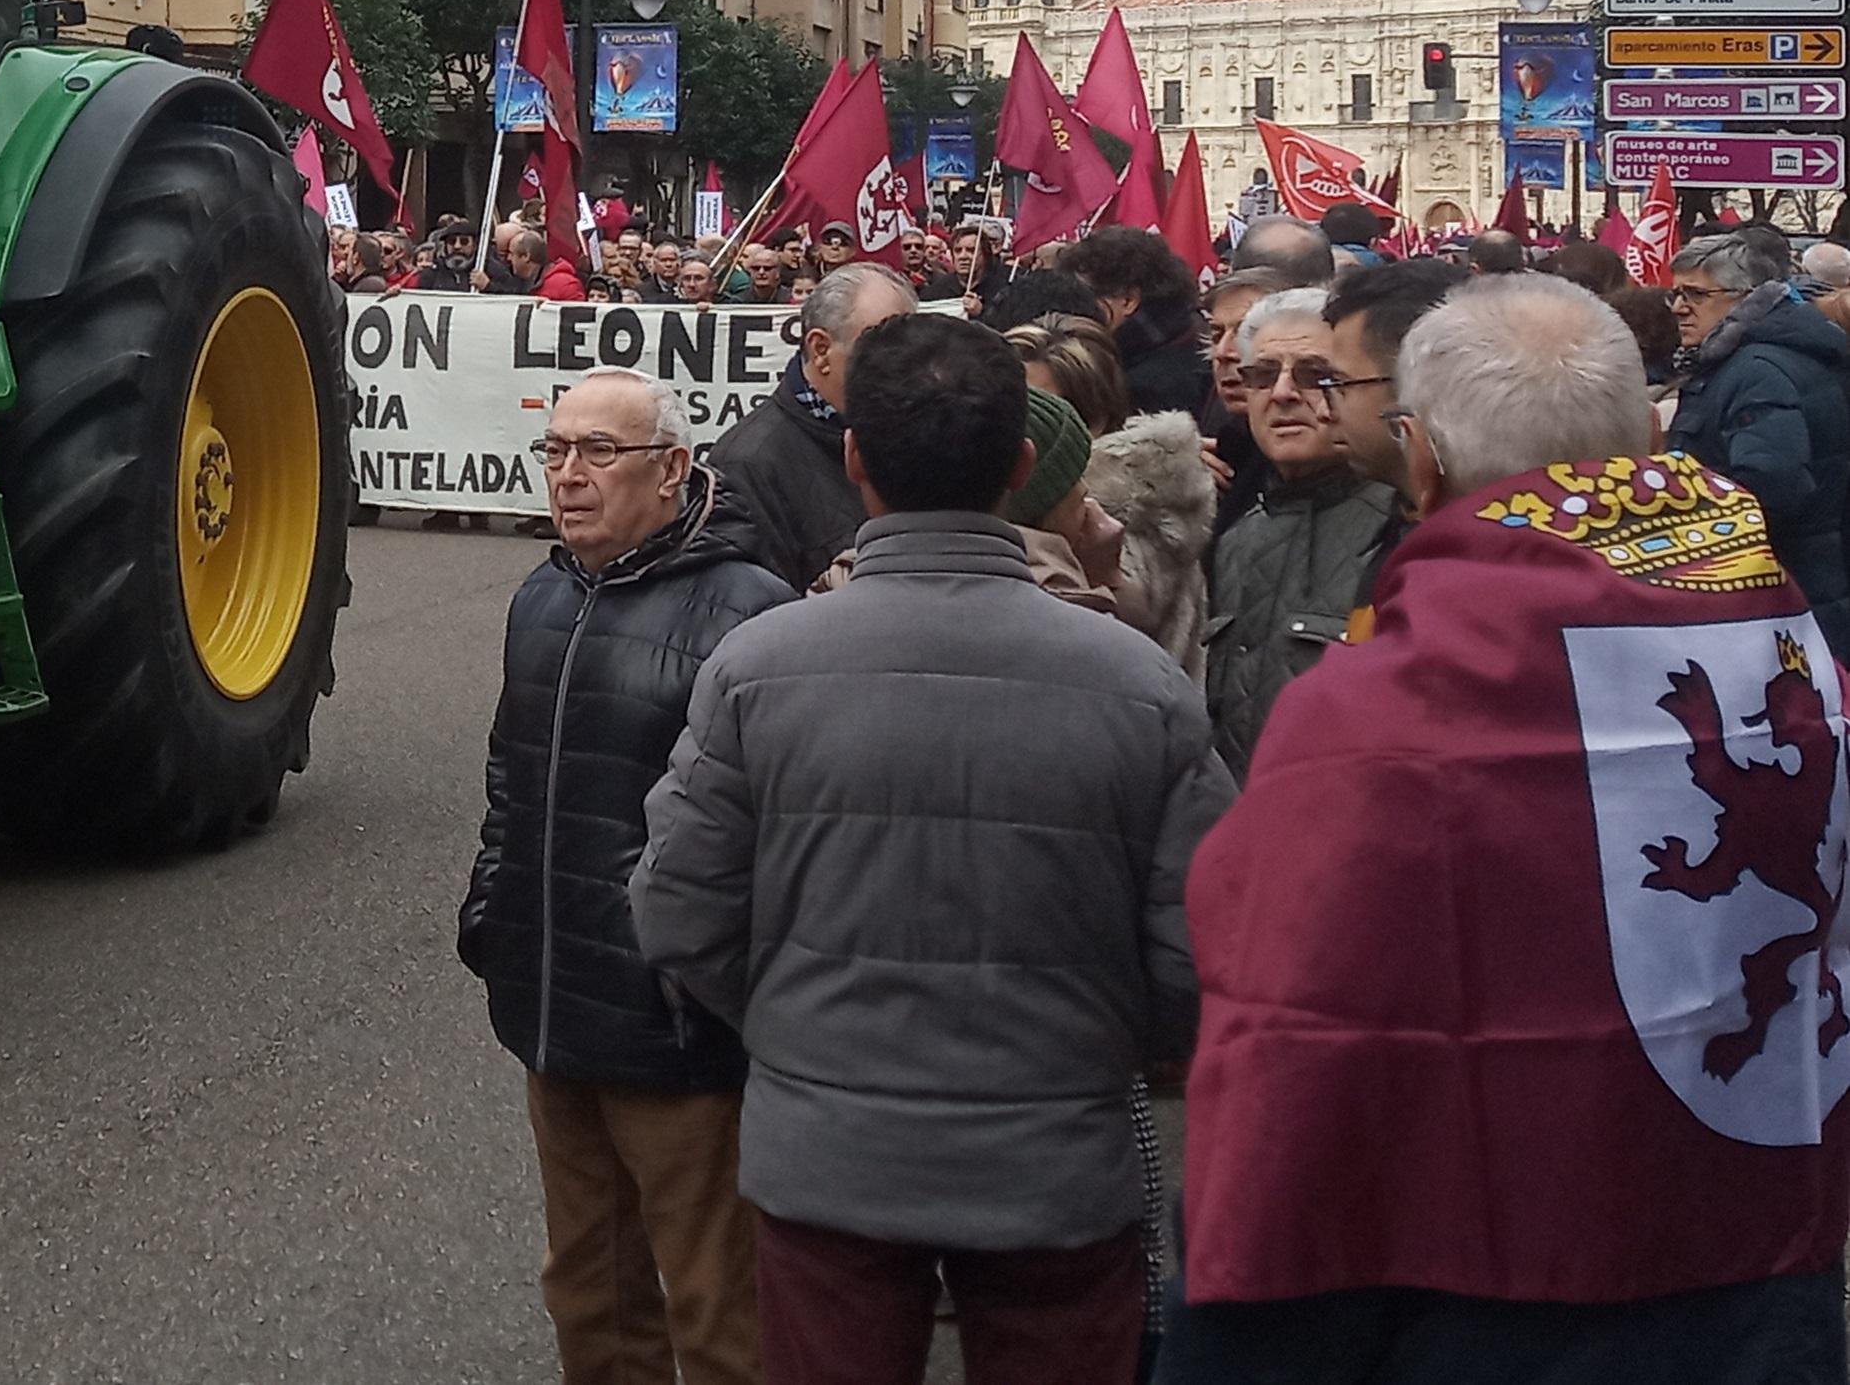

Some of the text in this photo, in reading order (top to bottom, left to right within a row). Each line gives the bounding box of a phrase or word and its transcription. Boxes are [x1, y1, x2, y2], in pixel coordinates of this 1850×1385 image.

[1614, 40, 1717, 53] aparcamiento
[1722, 37, 1765, 53] Eras
[1616, 92, 1730, 108] San Marcos
[1615, 140, 1718, 151] museo de arte
[1615, 152, 1730, 165] contemporáneo
[350, 450, 534, 495] NTELADA
